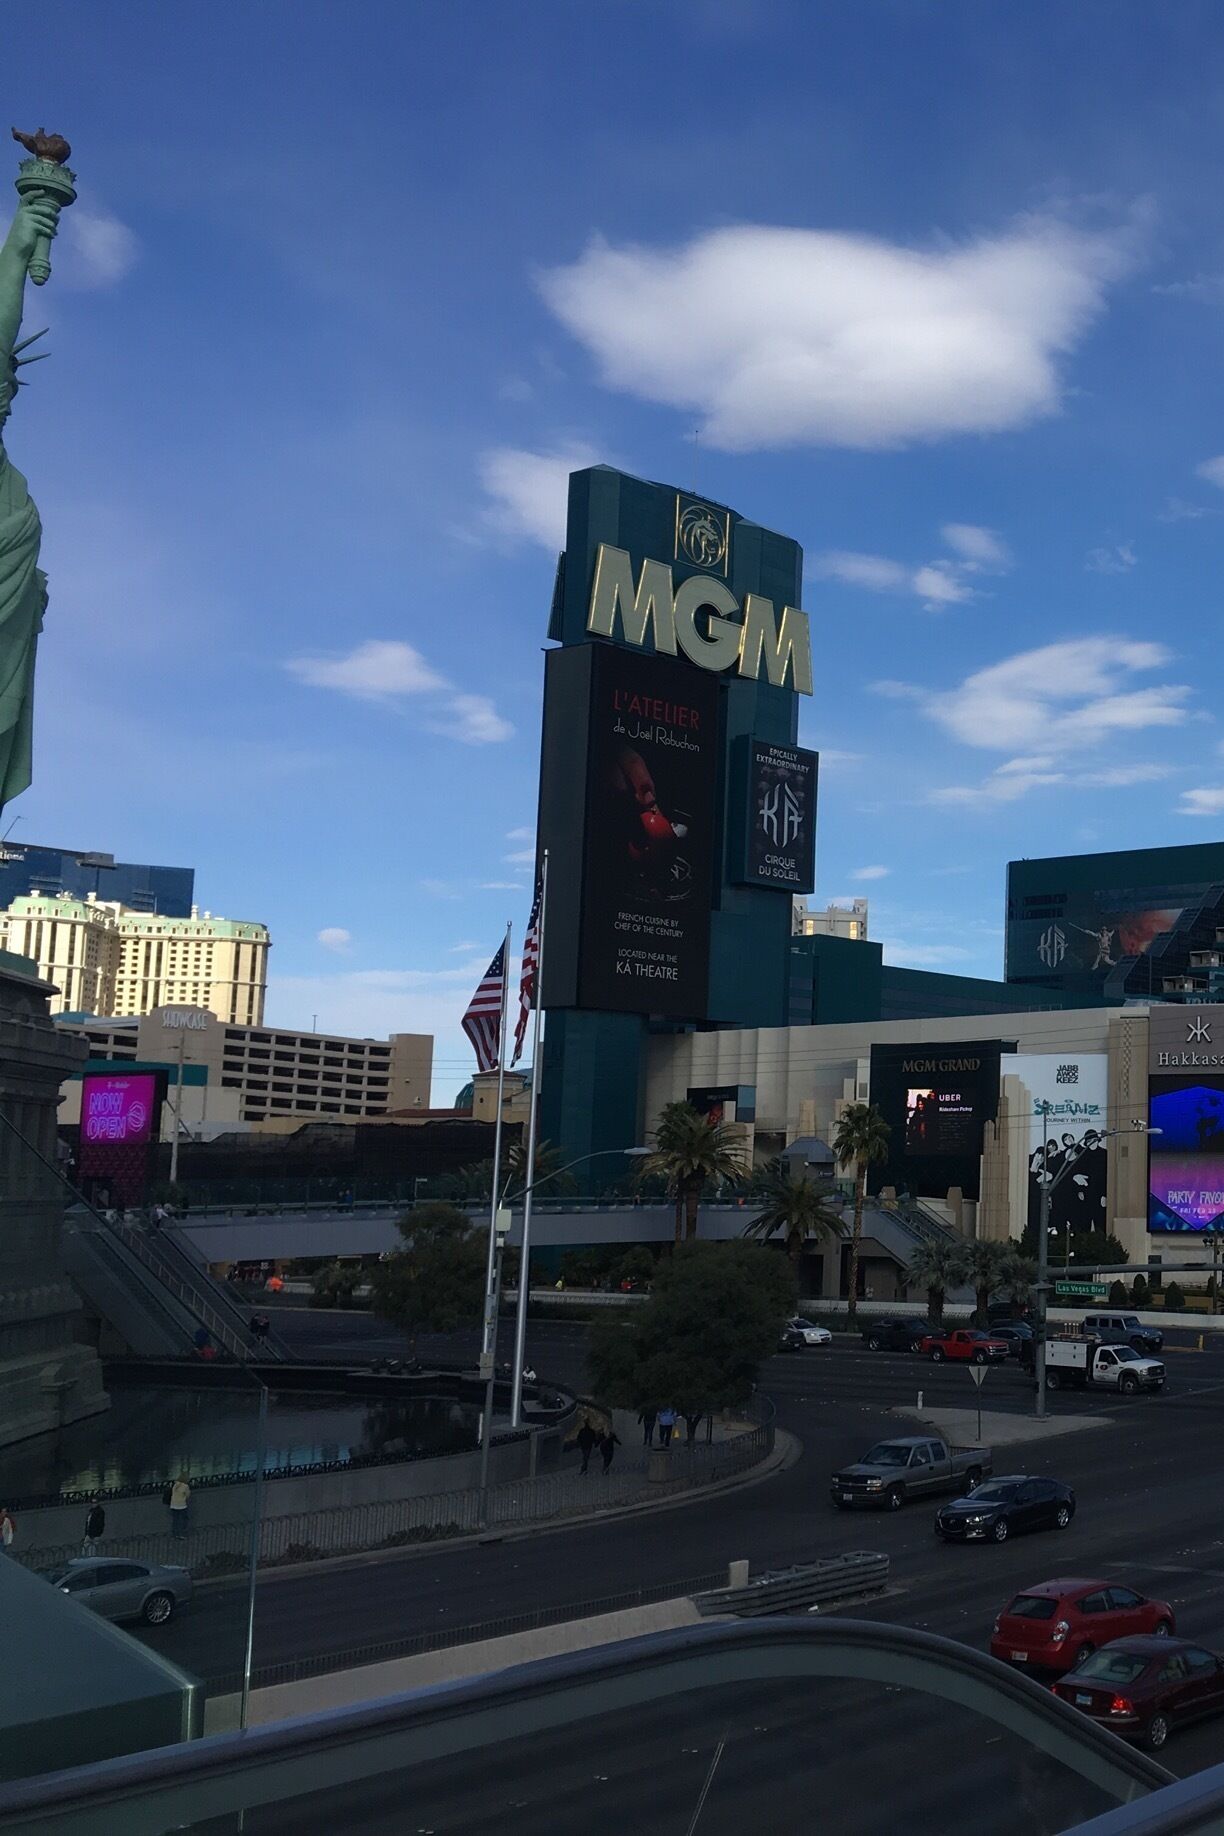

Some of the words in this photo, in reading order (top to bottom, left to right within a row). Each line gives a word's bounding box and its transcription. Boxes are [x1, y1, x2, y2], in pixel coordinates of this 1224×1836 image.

[586, 542, 813, 696] MGM
[613, 689, 700, 730] L'ATELIER
[613, 717, 626, 734] de
[656, 726, 700, 752] Robuchon
[769, 747, 798, 761] EPICALLY
[756, 754, 810, 774] EXTRAORDINARY
[764, 854, 796, 870] CIRQUE
[759, 866, 772, 876] DU
[774, 868, 800, 881] SOLEIL
[614, 921, 631, 930] CHEF
[632, 924, 641, 932] OF
[643, 925, 654, 934] THE
[671, 920, 679, 928] BY
[635, 963, 678, 980] THEATRE
[162, 1010, 208, 1030] SHOWCASE
[902, 1060, 936, 1072] MGM
[939, 1058, 980, 1071] GRAND
[89, 1092, 124, 1115] NOW
[939, 1094, 961, 1102] UBER
[87, 1116, 127, 1139] OPEN
[1168, 1190, 1196, 1204] PARTY
[1058, 1284, 1069, 1292] Las
[1070, 1285, 1089, 1294] Vegas
[1091, 1286, 1105, 1294] Blvd
